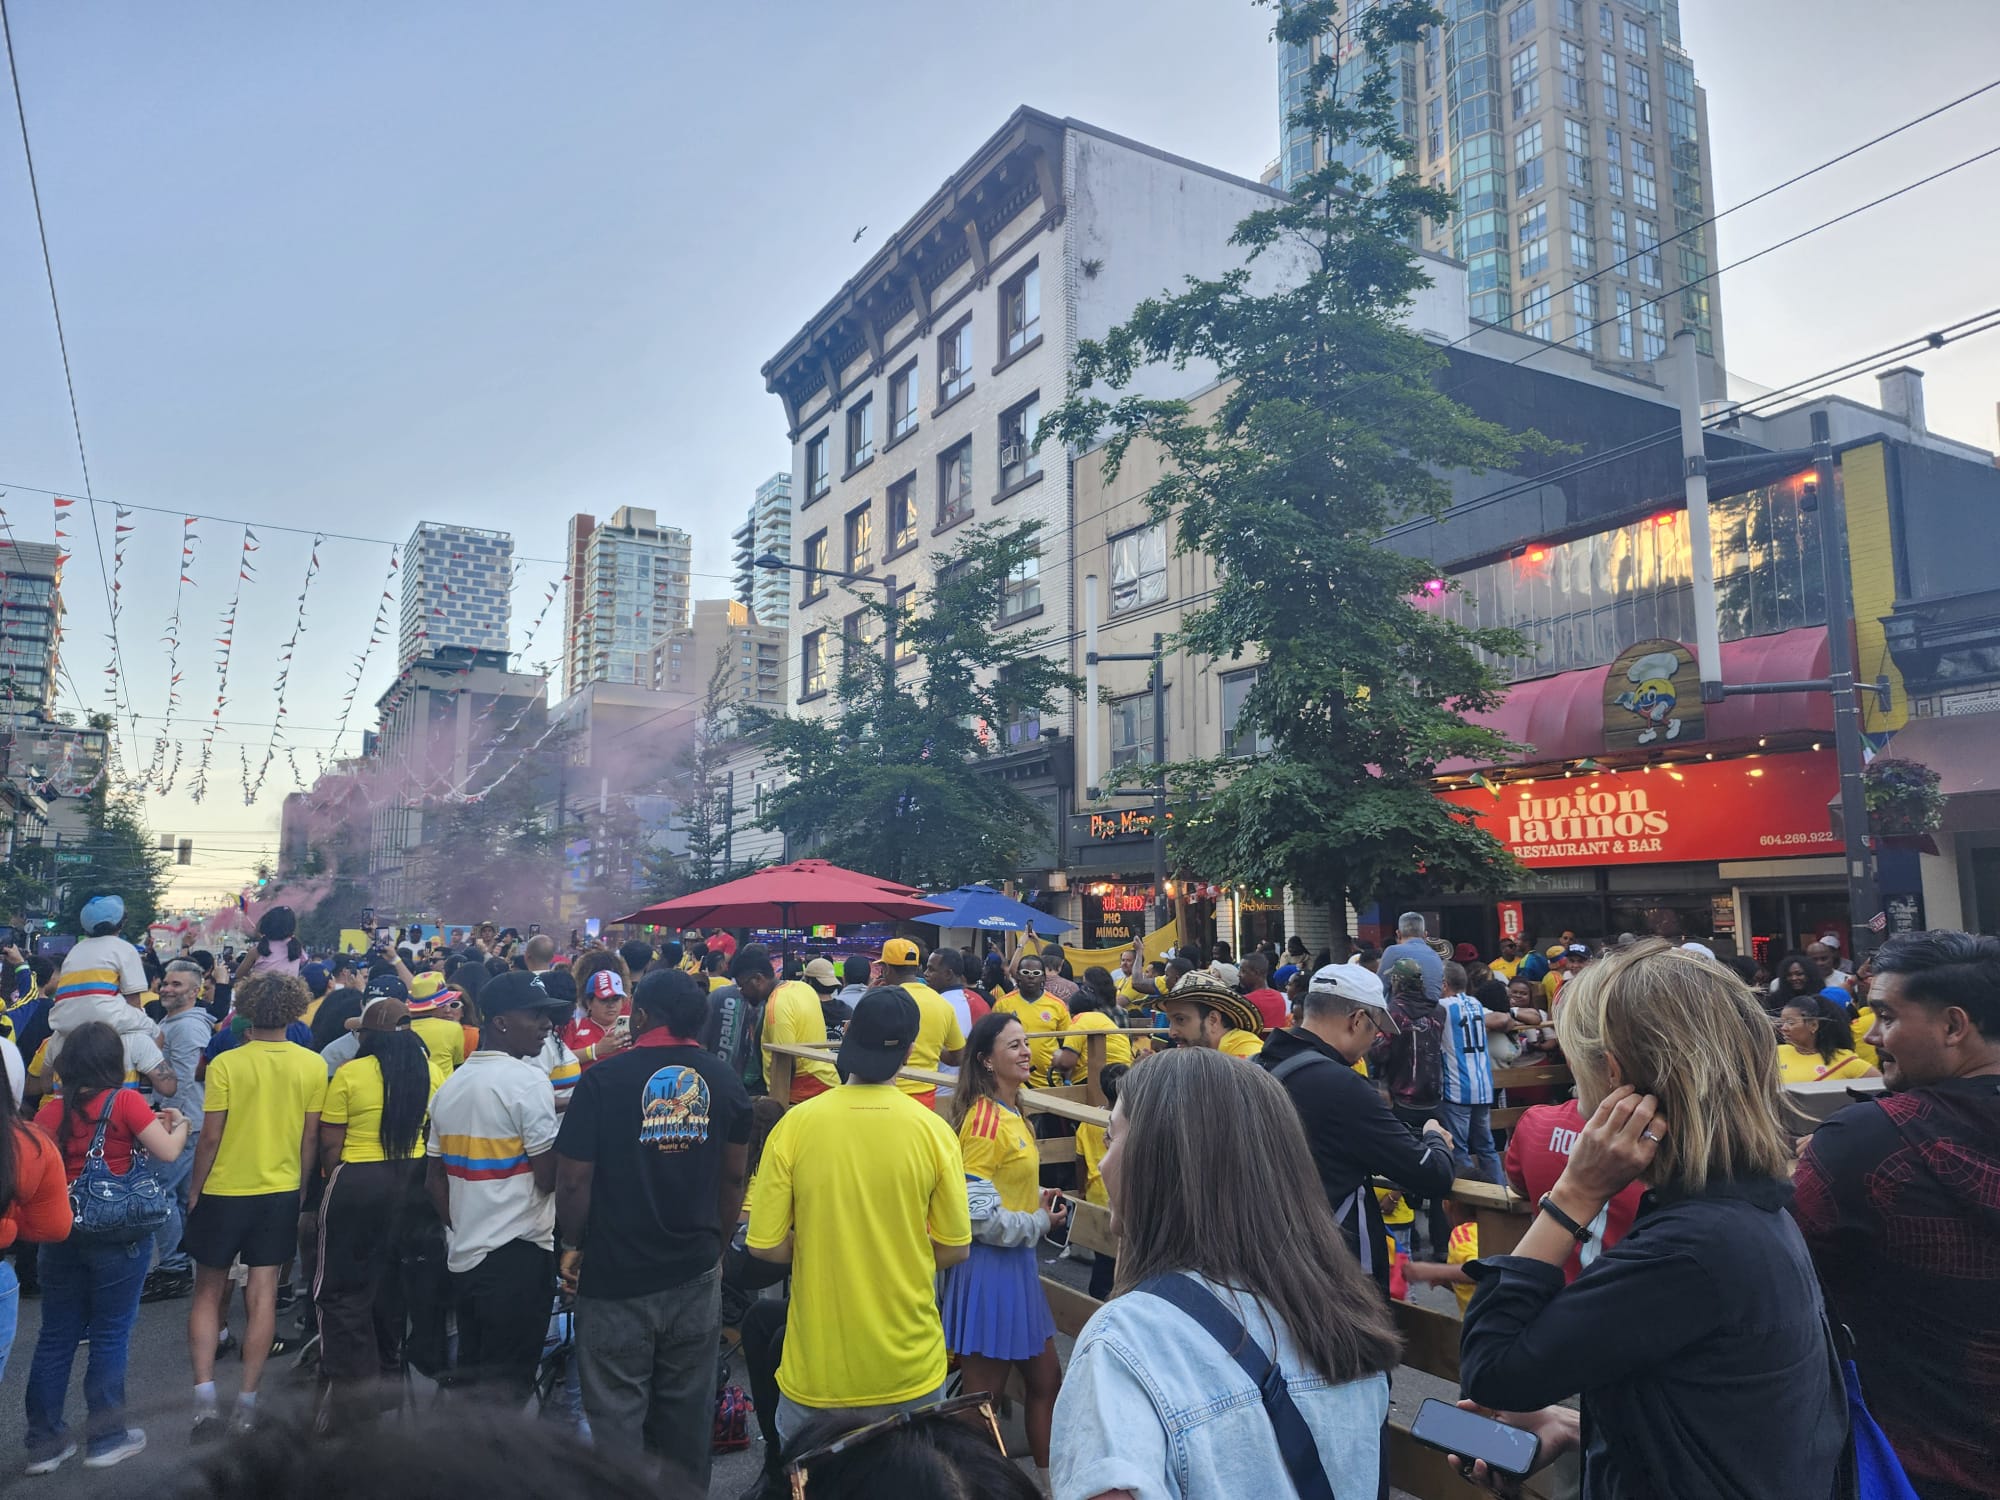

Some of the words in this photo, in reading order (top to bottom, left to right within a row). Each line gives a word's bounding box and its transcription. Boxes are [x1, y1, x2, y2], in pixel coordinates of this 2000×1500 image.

[1518, 787, 1649, 821] union
[1508, 809, 1669, 843] latinos
[1760, 831, 1837, 846] 604.269.922
[1513, 841, 1609, 858] RESTAURANT
[1613, 840, 1624, 853] &
[1628, 838, 1663, 852] BAR
[1096, 926, 1130, 938] MIMOSA
[1104, 912, 1121, 924] PHO
[719, 998, 736, 1049] paulo
[1459, 1015, 1485, 1053] 10
[1549, 1127, 1583, 1155] RO
